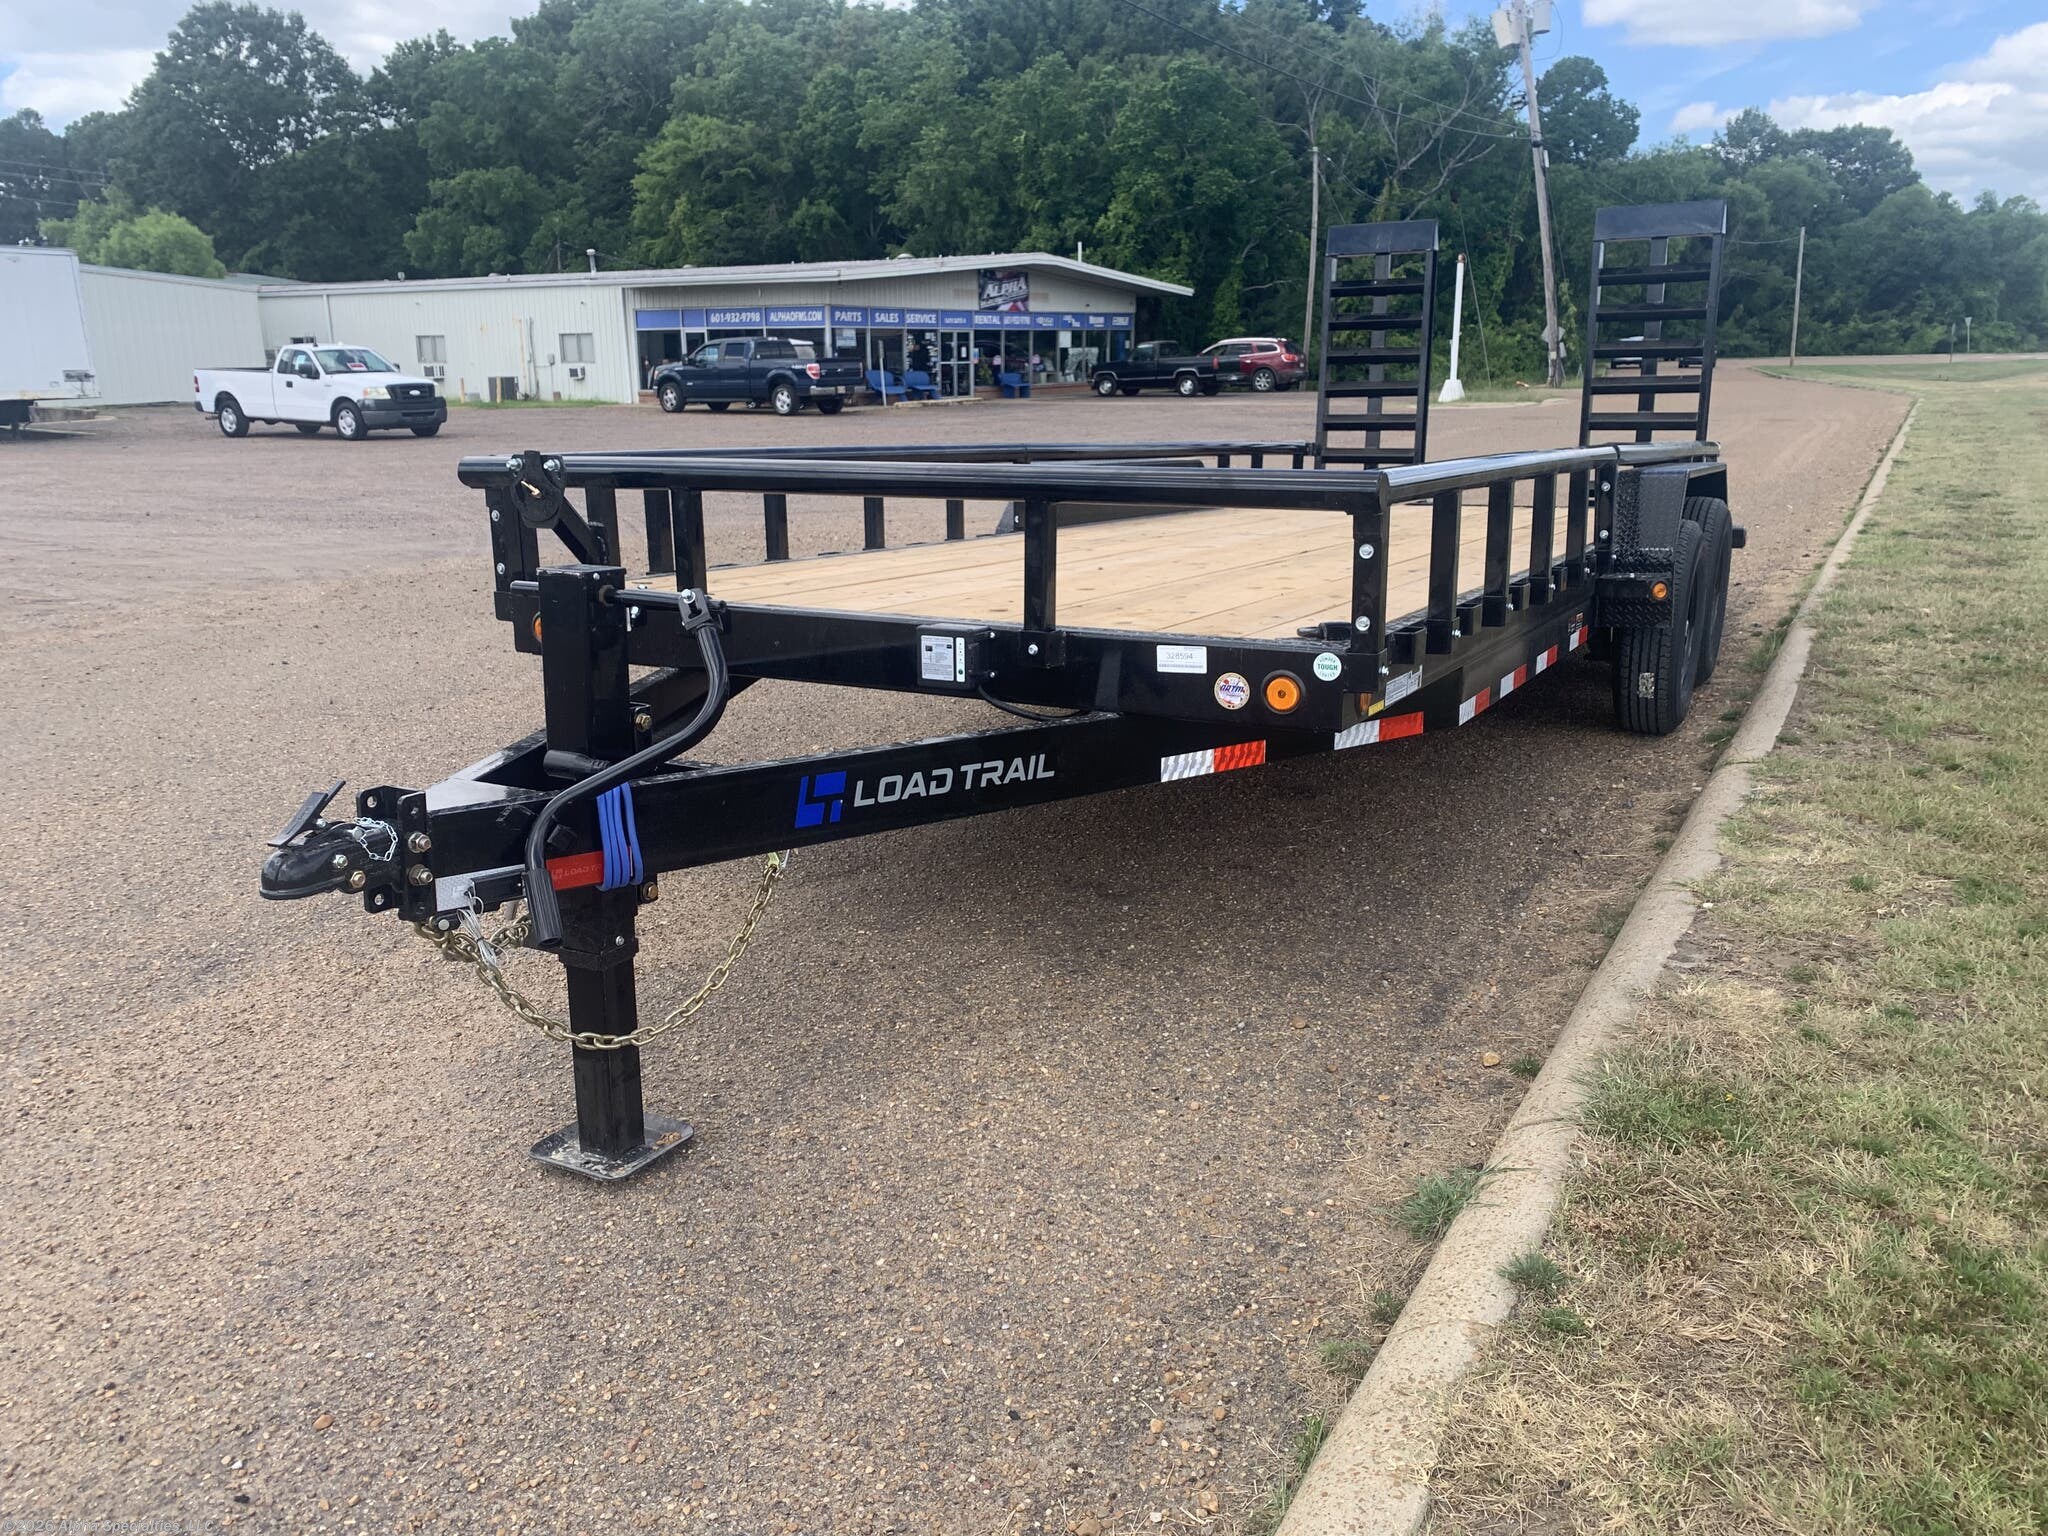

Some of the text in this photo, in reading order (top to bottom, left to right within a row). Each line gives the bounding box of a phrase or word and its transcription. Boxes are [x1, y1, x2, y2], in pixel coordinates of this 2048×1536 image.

[983, 277, 1027, 299] ALPHA
[834, 311, 862, 322] PARTS
[874, 312, 899, 323] SALES
[905, 314, 937, 324] SERVICE
[975, 315, 1000, 325] RENTAL
[1318, 663, 1338, 671] TOUGH
[853, 767, 953, 808] LOAD
[960, 753, 1055, 790] TRAIL
